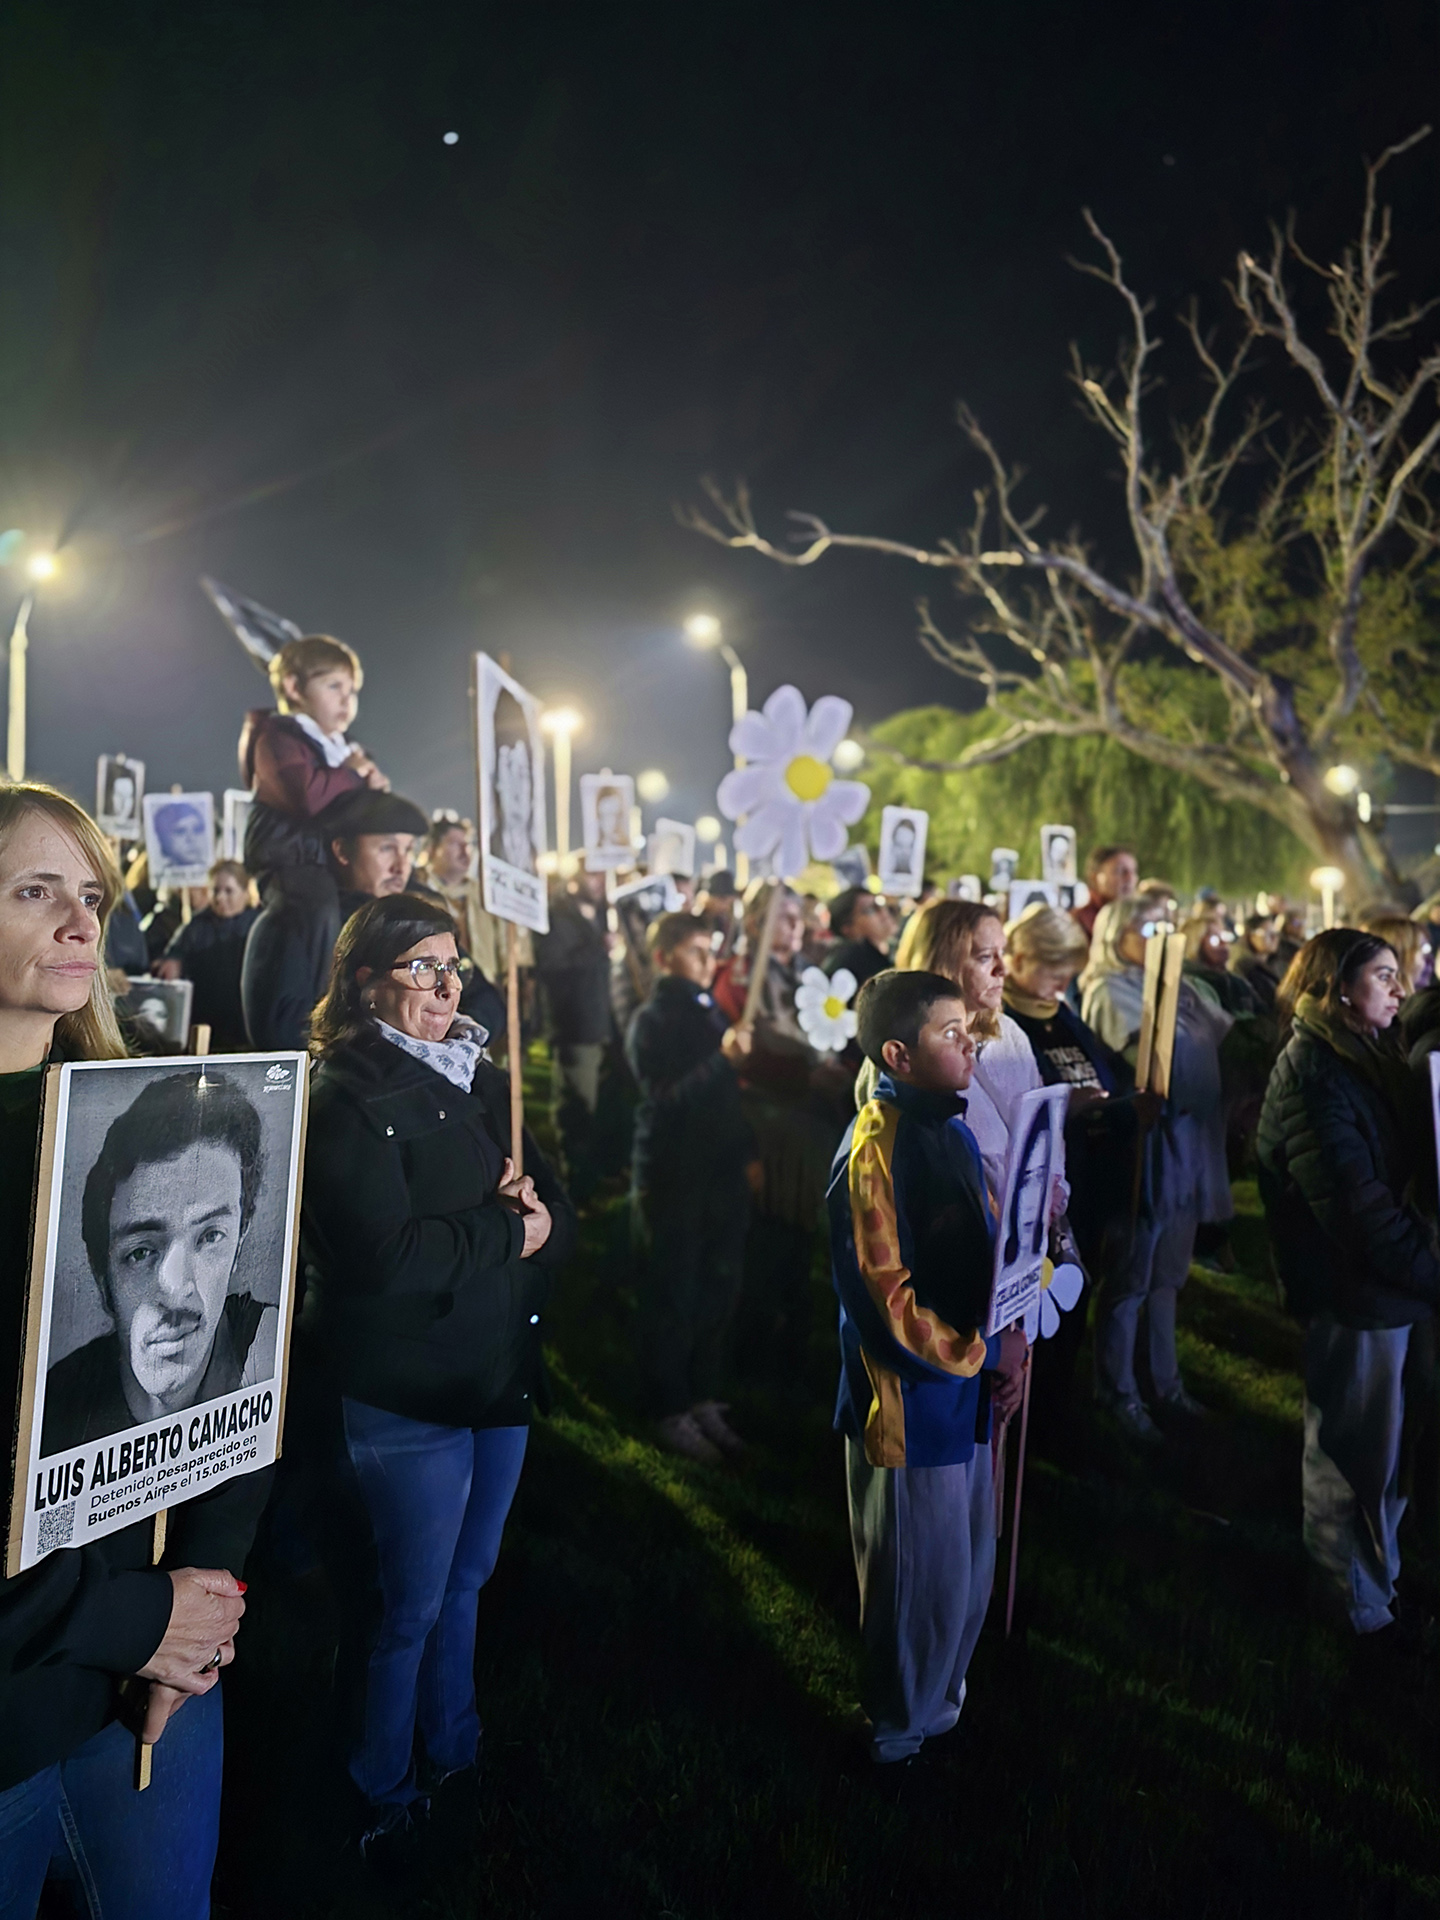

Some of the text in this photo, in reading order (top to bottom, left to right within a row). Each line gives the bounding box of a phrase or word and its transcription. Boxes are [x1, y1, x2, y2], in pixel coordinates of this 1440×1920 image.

[34, 1390, 273, 1512] LUIS ALBERTO CAMACHO
[87, 1447, 257, 1527] Buenos Aires el 15.08.1976
[91, 1434, 257, 1508] Detenido Desaparecido en
